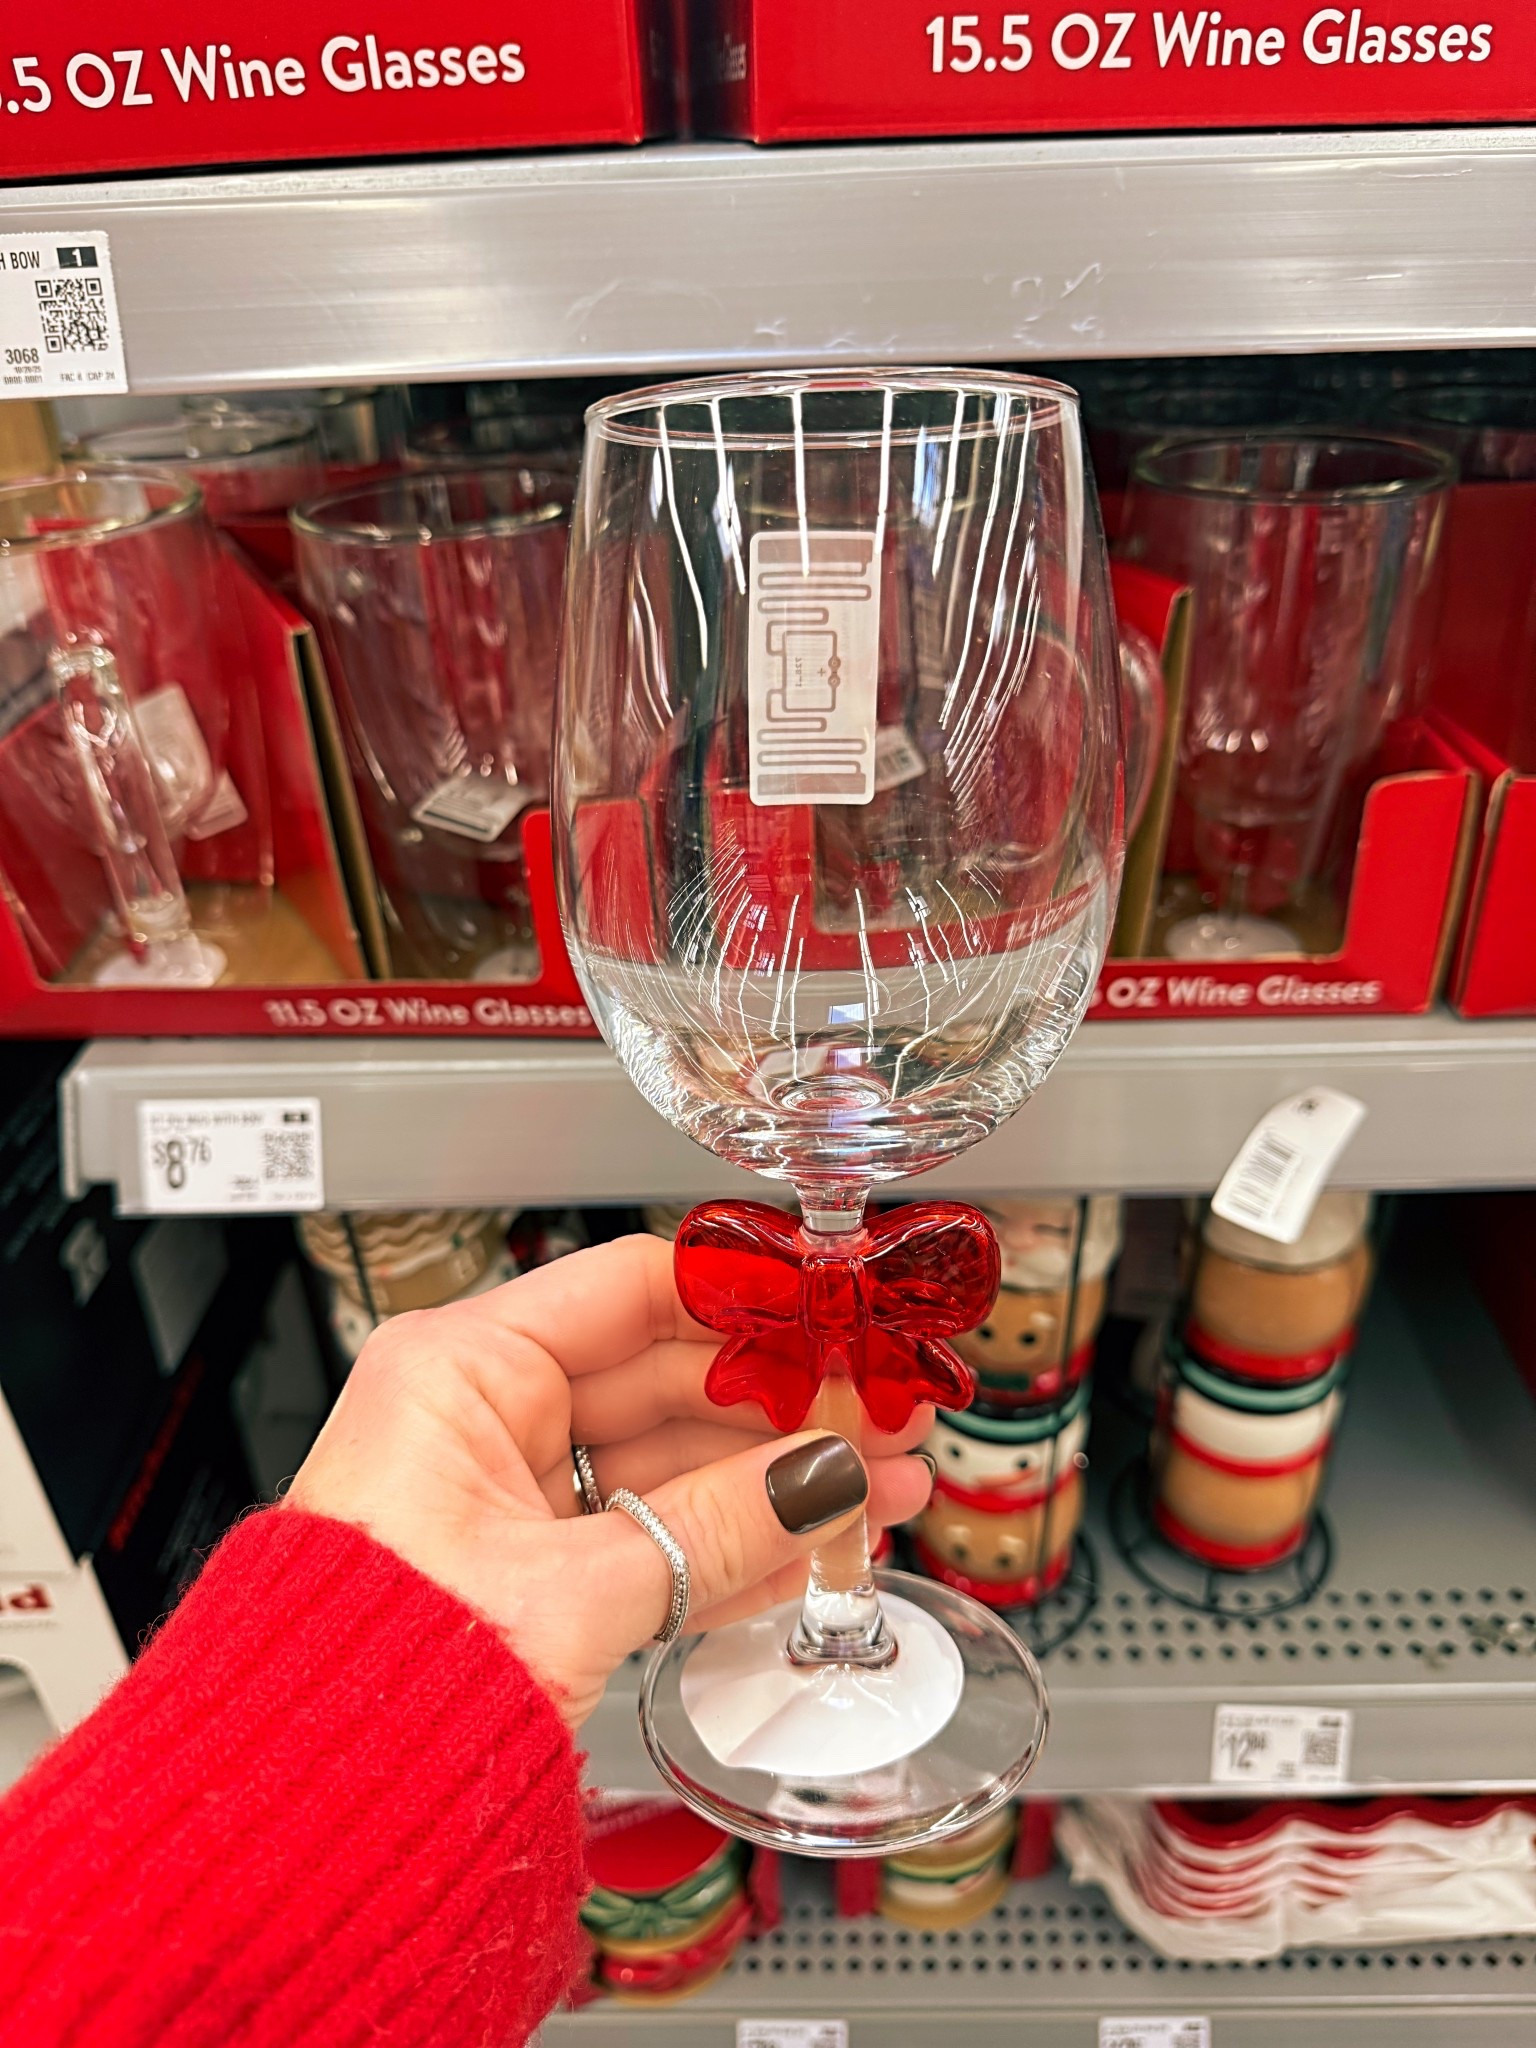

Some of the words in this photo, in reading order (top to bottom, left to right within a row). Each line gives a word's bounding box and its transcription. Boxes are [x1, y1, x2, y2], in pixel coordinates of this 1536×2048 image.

[927, 15, 1032, 73] 15.5
[1052, 13, 1136, 70] OZ
[1153, 11, 1285, 68] Wine
[1303, 9, 1493, 65] Glasses
[0, 56, 52, 114] .5
[66, 49, 153, 109] OZ
[160, 45, 306, 103] Wine
[321, 34, 525, 92] Glasses
[10, 251, 40, 270] BOW
[72, 248, 82, 267] 1
[5, 348, 40, 365] 3068
[1107, 978, 1160, 1008] OZ
[1166, 976, 1250, 1006] Wine
[1257, 974, 1382, 1006] Glasses
[264, 1000, 327, 1027] 11.5
[328, 999, 384, 1027] OZ
[385, 999, 470, 1026] Wine
[472, 998, 593, 1027] Glasses
